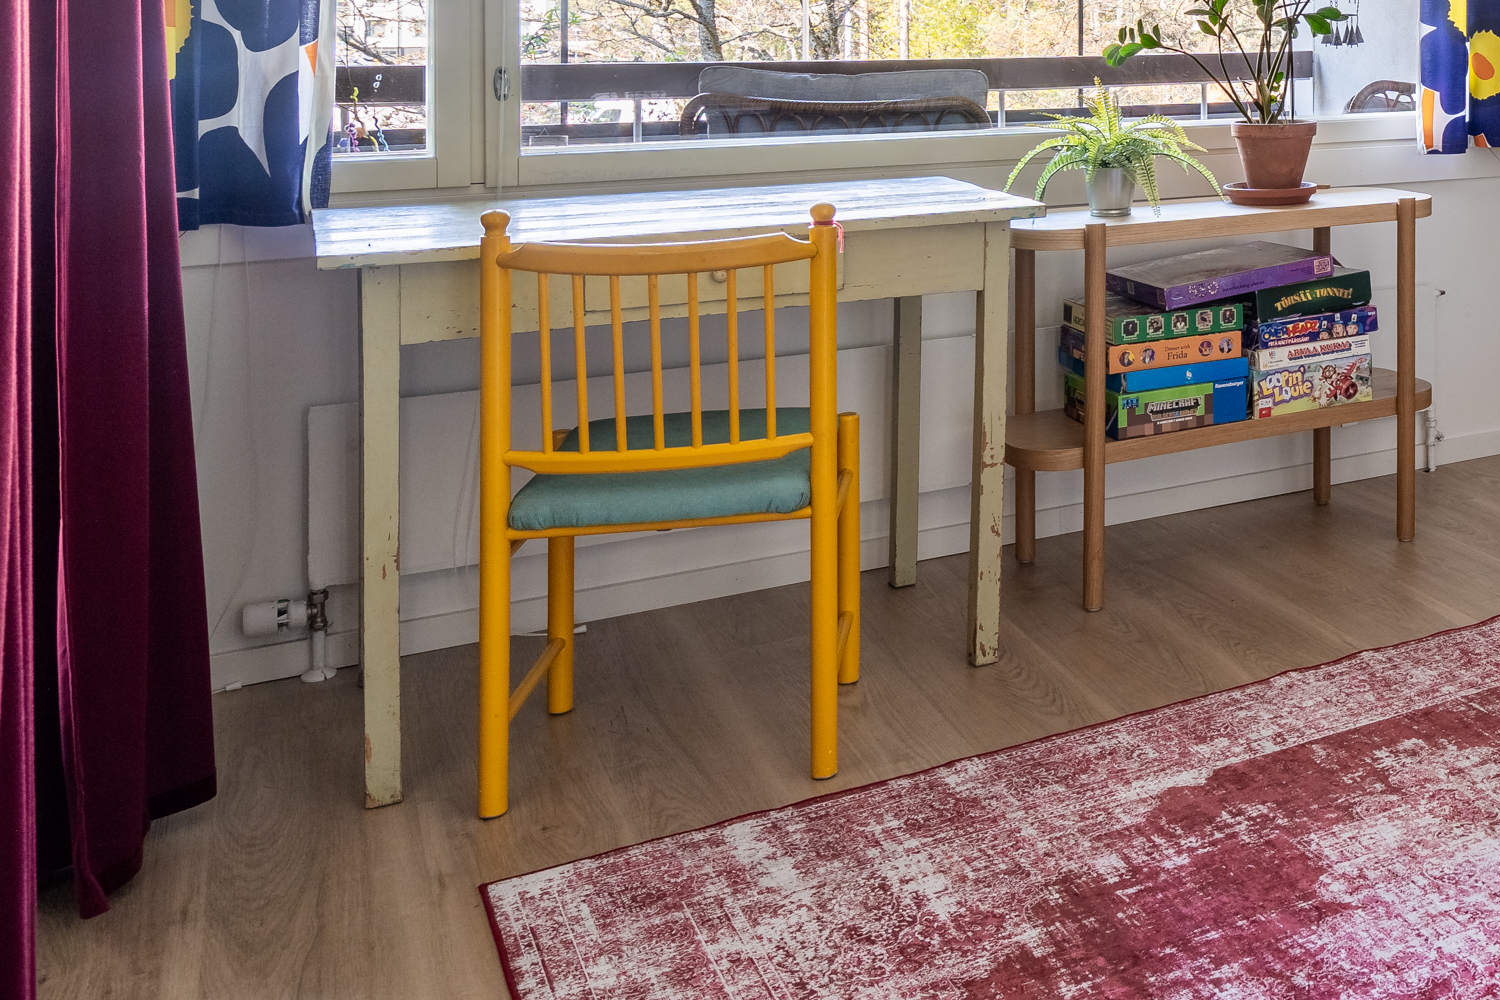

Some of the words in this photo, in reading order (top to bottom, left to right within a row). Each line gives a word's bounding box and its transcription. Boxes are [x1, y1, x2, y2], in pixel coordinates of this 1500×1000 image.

[1167, 351, 1188, 360] Frida
[1288, 344, 1319, 358] ARVAA
[1320, 341, 1352, 352] KUKA?
[1215, 381, 1244, 389] Ravensburger
[1274, 383, 1311, 402] Louie
[1148, 397, 1202, 412] MINECRAFT
